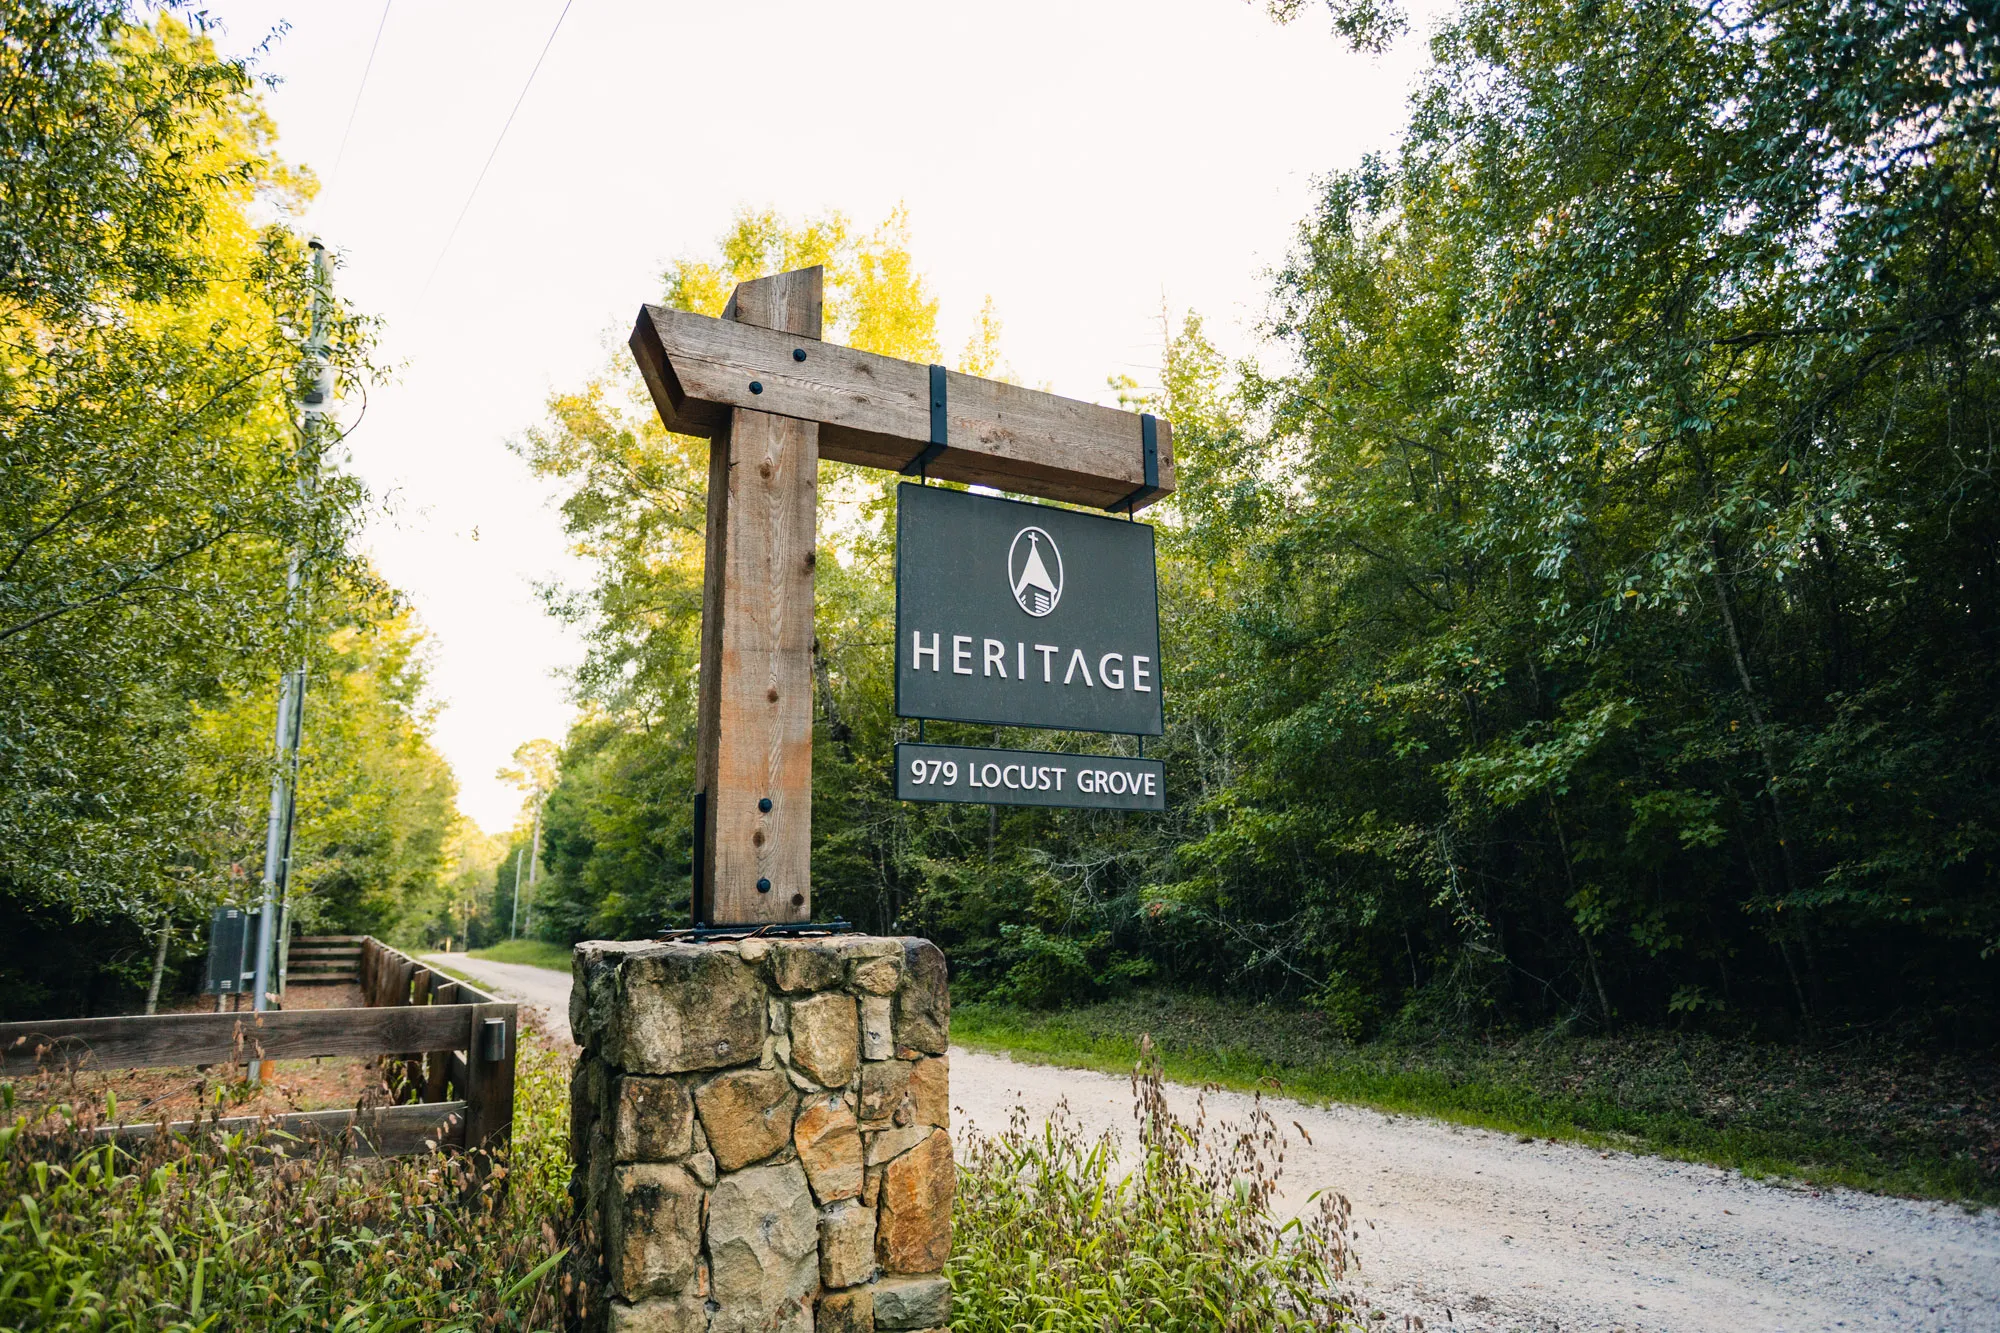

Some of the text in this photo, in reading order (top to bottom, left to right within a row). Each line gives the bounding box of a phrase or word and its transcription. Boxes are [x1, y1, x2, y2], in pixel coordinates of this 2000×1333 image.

[912, 630, 1151, 692] HERITAGE
[911, 759, 1156, 796] 979 LOCUST GROVE
